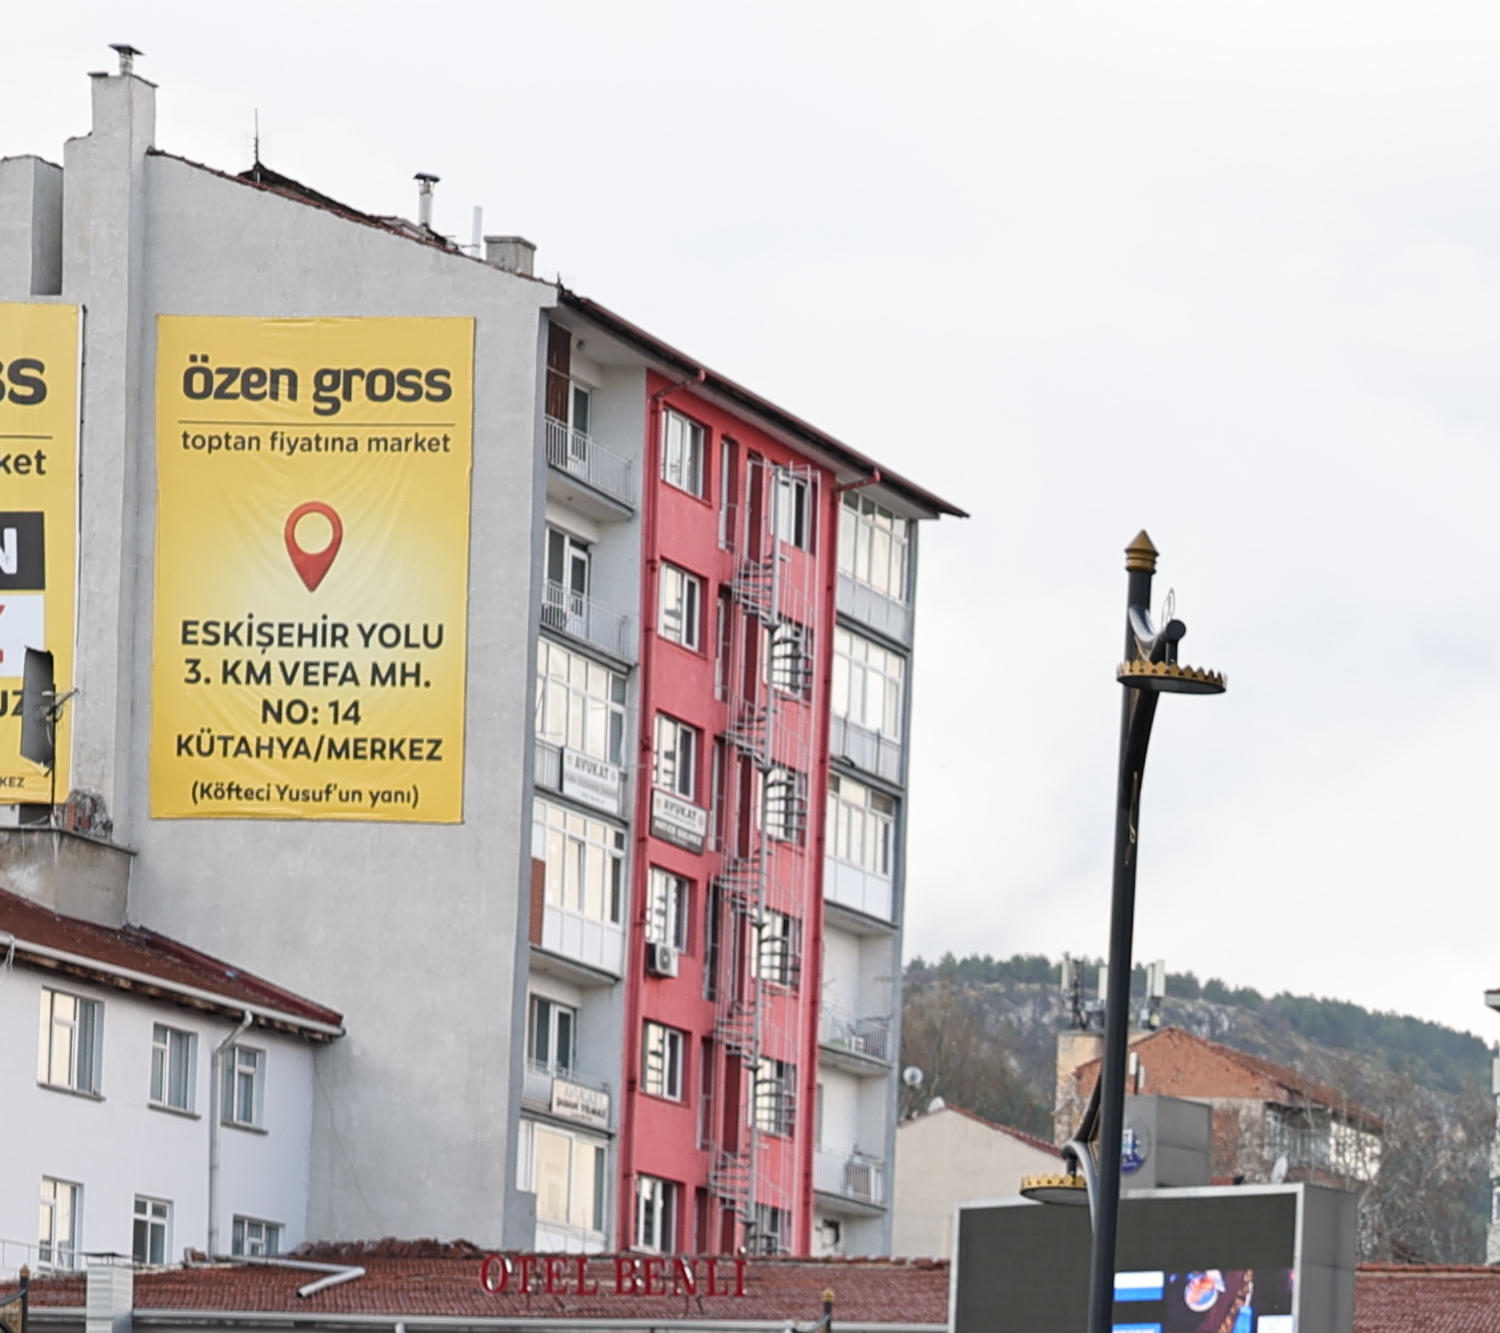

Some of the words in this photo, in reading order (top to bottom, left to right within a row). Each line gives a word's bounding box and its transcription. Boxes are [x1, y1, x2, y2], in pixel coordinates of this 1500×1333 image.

[182, 353, 299, 402] özen
[311, 366, 453, 416] gross
[181, 430, 261, 454] toptan
[269, 430, 359, 456] fiyatına
[366, 431, 452, 453] market
[180, 613, 350, 655] ESKİŞEHİR
[356, 622, 445, 650] YOLU
[183, 658, 212, 685] 3.
[221, 659, 272, 686] KM
[278, 661, 361, 687] VEFA
[369, 662, 432, 688] MH.
[260, 698, 320, 726] NO:
[327, 699, 362, 726] 14
[175, 727, 444, 763] KÜTAHYA/MERKEZ
[191, 780, 273, 806] (Köfteci
[368, 784, 420, 810] yanı)
[478, 1253, 599, 1298] OTEL
